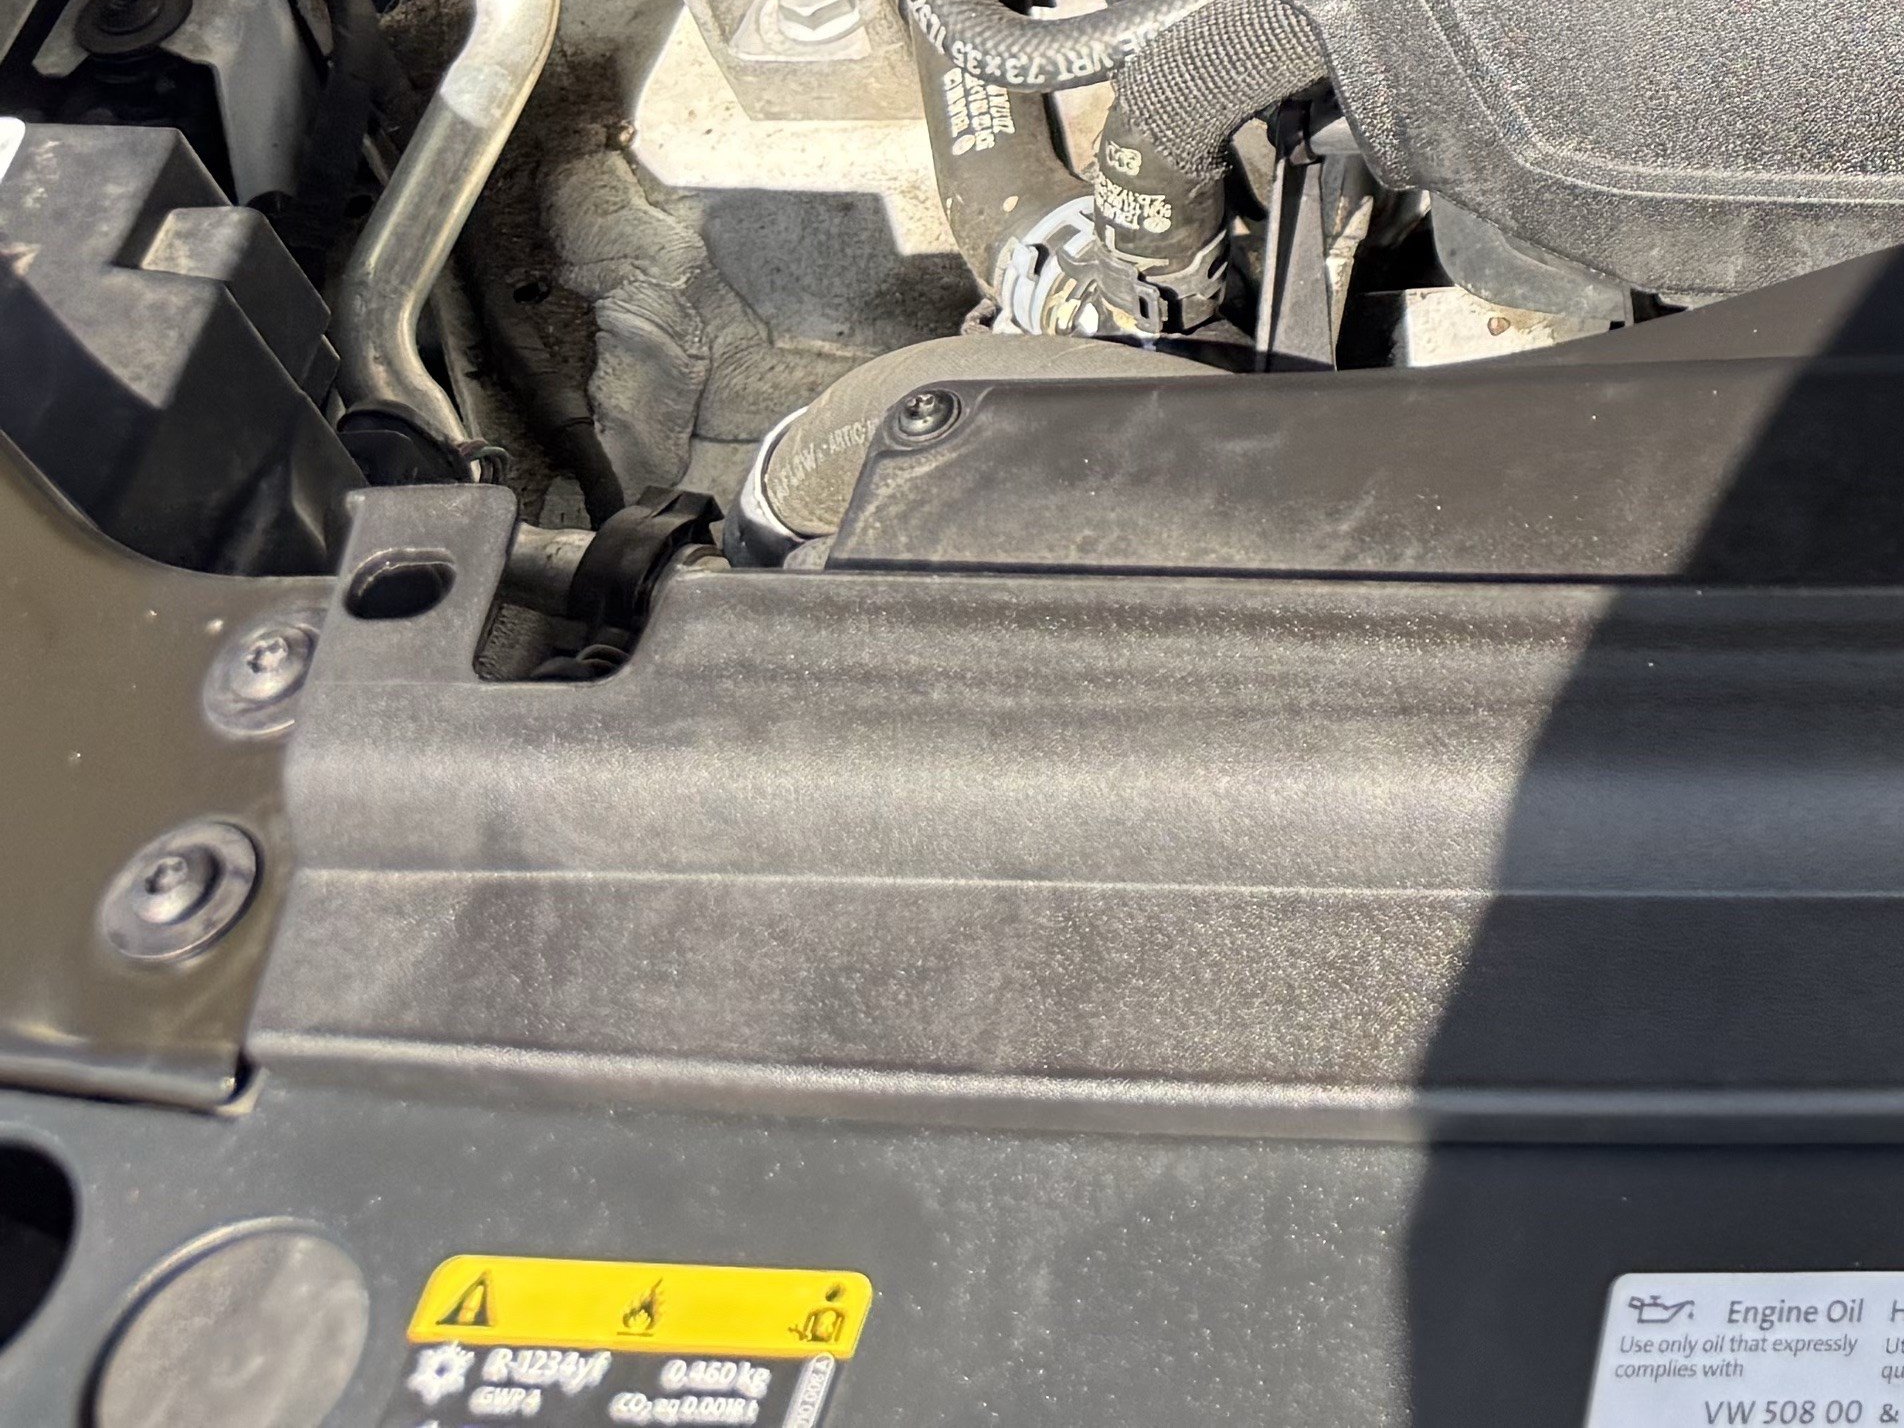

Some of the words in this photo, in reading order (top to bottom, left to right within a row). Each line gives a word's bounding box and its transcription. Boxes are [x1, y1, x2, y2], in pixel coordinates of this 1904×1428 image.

[1726, 1299, 1822, 1329] Engine
[1826, 1298, 1864, 1324] Oil
[1619, 1335, 1655, 1354] Use
[1657, 1334, 1698, 1358] only
[1701, 1333, 1725, 1353] oil
[1728, 1334, 1769, 1354] that
[1771, 1333, 1859, 1359] expressly
[482, 1348, 613, 1395] R-1234yf
[735, 1360, 773, 1399] kg
[1614, 1358, 1697, 1382] complies
[1701, 1358, 1745, 1379] with
[468, 1386, 527, 1416] GWP
[1704, 1399, 1759, 1426] VW
[1763, 1399, 1816, 1425] 508
[1824, 1399, 1864, 1425] 00
[1879, 1401, 1900, 1425] &
